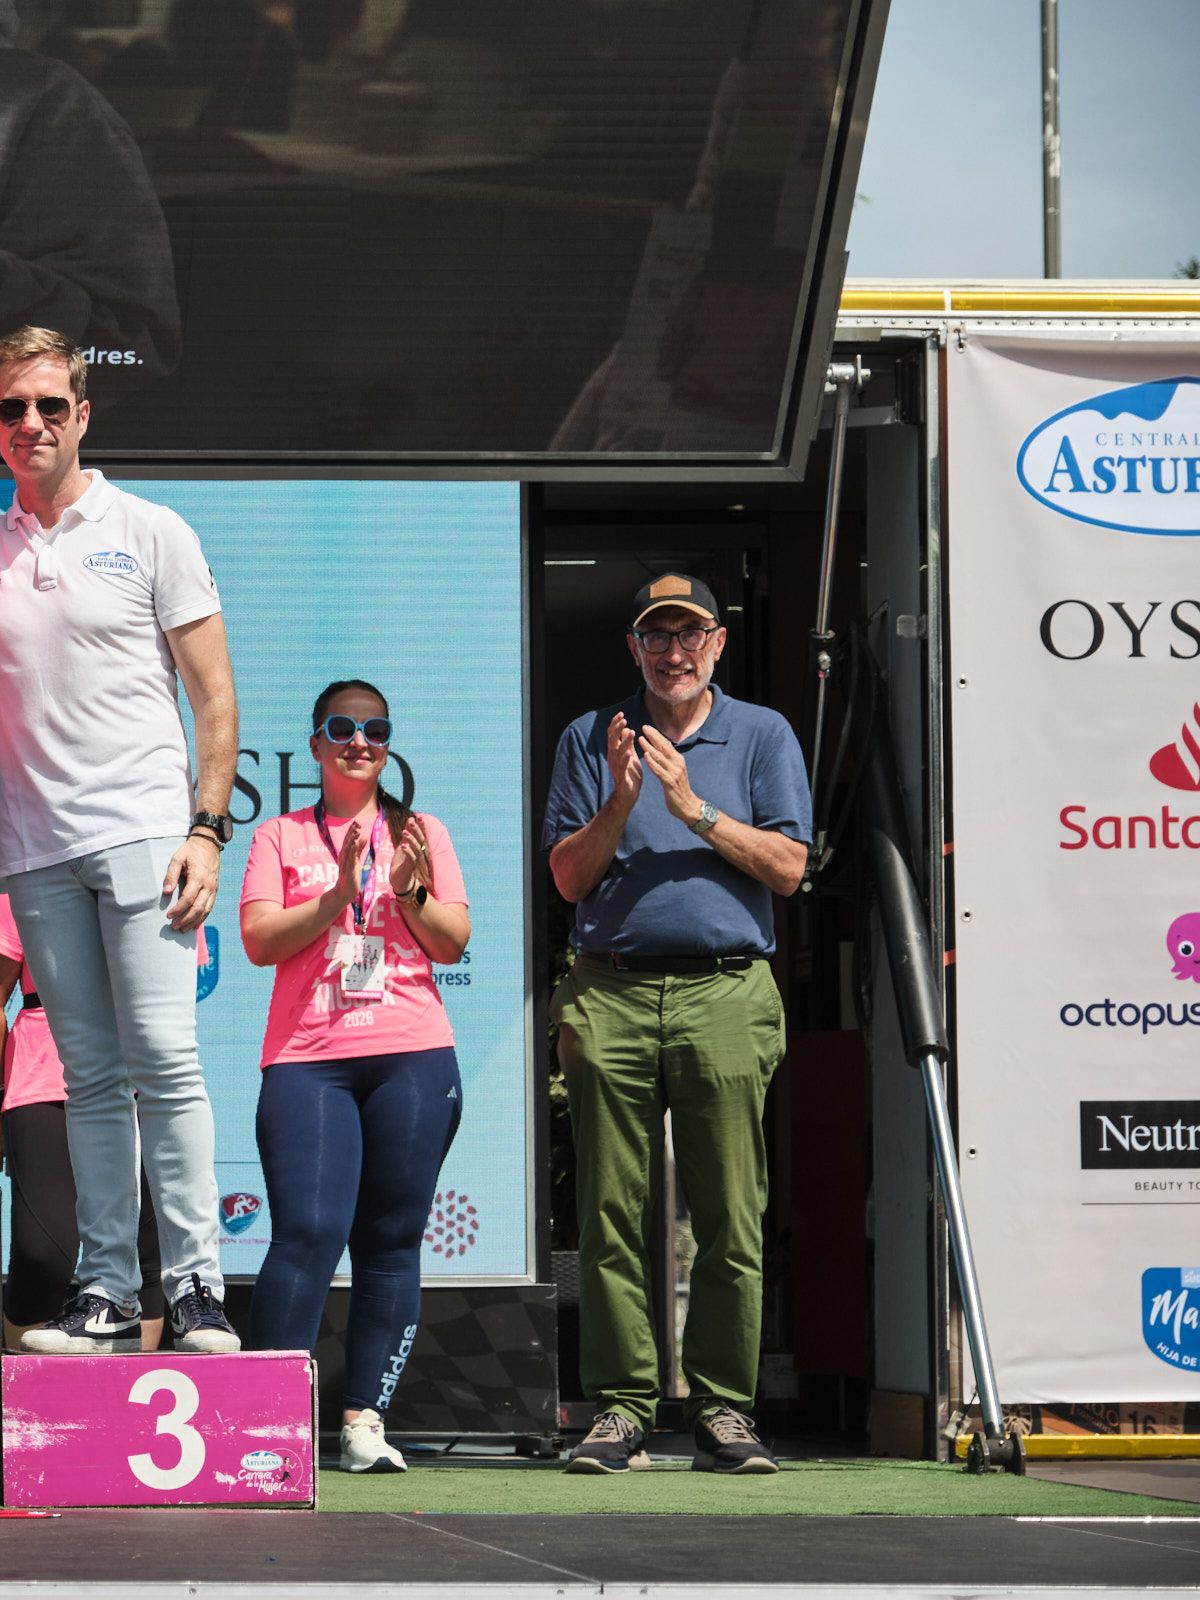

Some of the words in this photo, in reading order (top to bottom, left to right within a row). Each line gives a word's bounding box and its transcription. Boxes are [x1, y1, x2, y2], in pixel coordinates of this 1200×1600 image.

[82, 346, 144, 365] dres.
[87, 558, 133, 570] ASTURIANA
[344, 1010, 375, 1028] 2026
[1134, 1181, 1184, 1191] BEAUTY
[1156, 1342, 1180, 1362] HIJA
[1182, 1355, 1198, 1367] DE
[127, 1368, 206, 1490] 3
[238, 1469, 272, 1480] Carrera
[258, 1480, 285, 1495] Mujer
